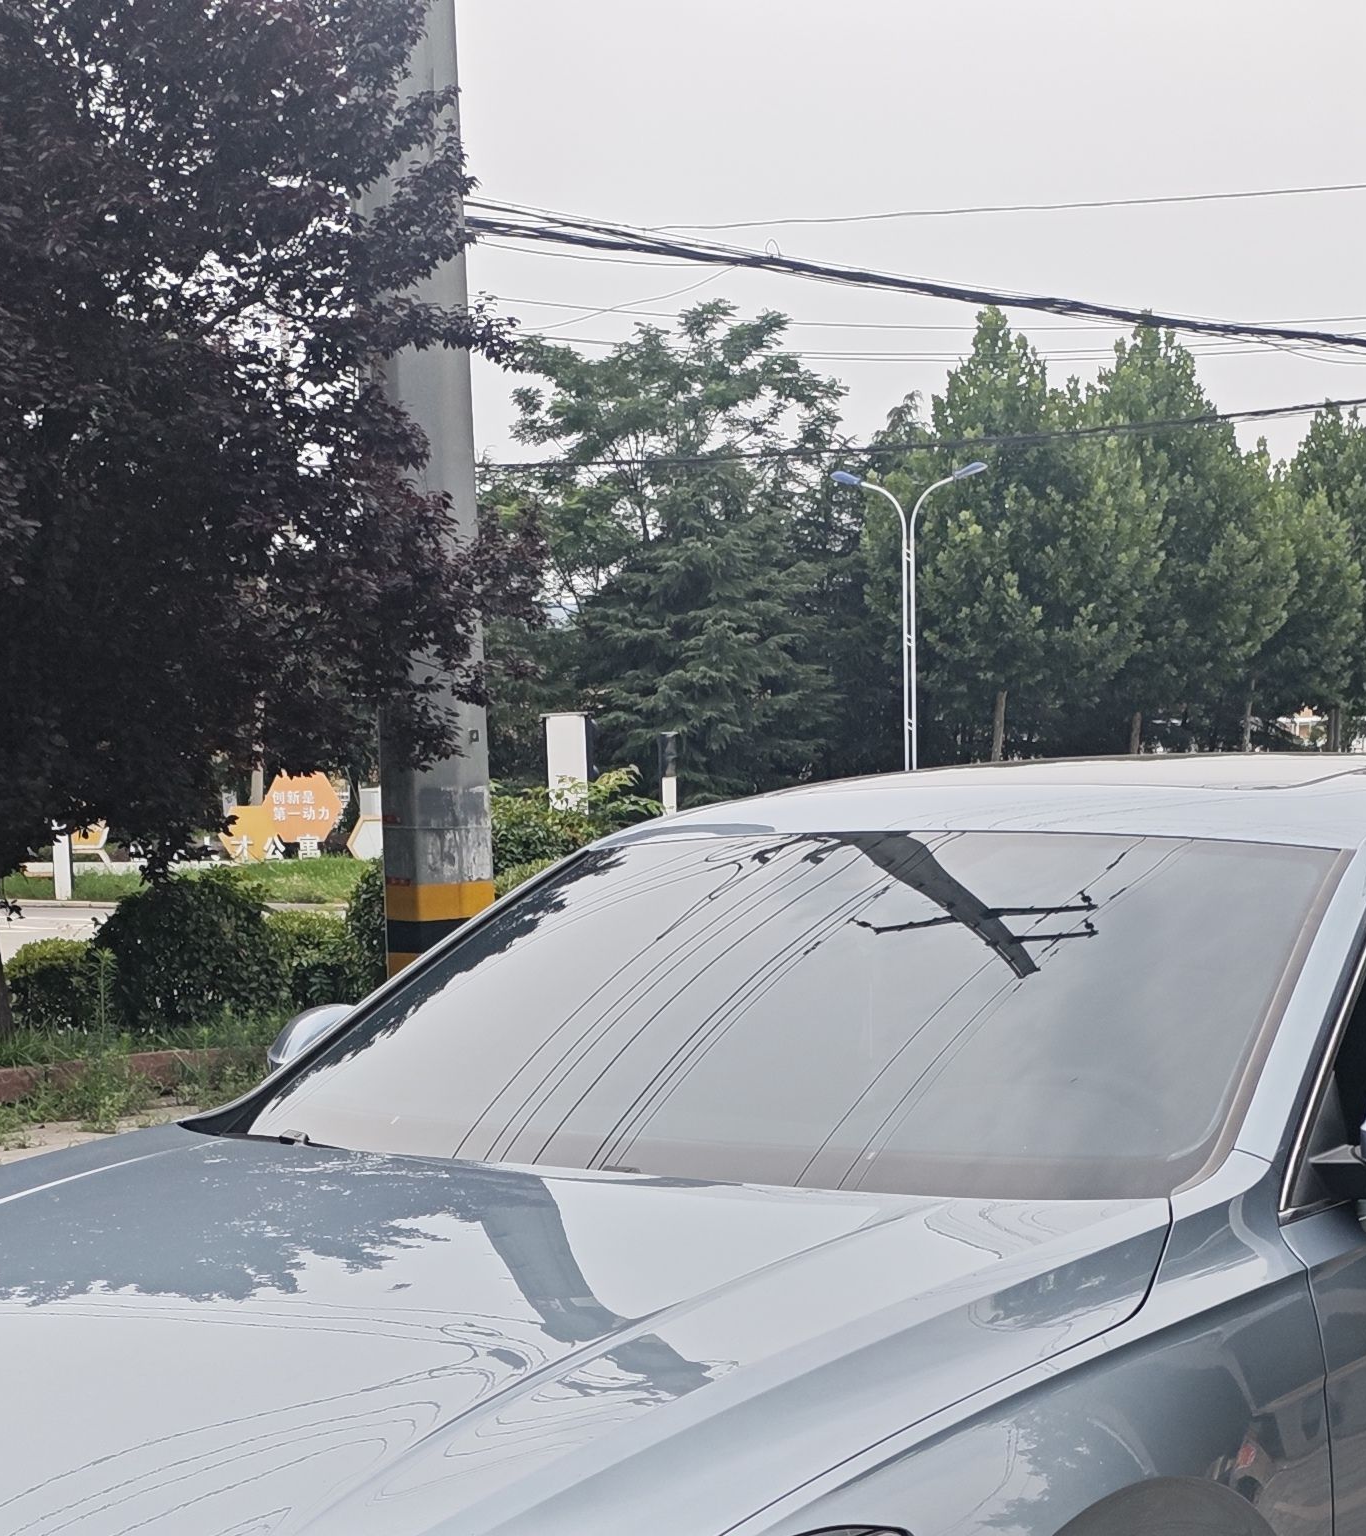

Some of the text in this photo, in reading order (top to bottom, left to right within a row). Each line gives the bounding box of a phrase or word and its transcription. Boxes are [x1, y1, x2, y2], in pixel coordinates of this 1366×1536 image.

[272, 790, 315, 805] 创新是
[273, 805, 330, 822] 第一动力
